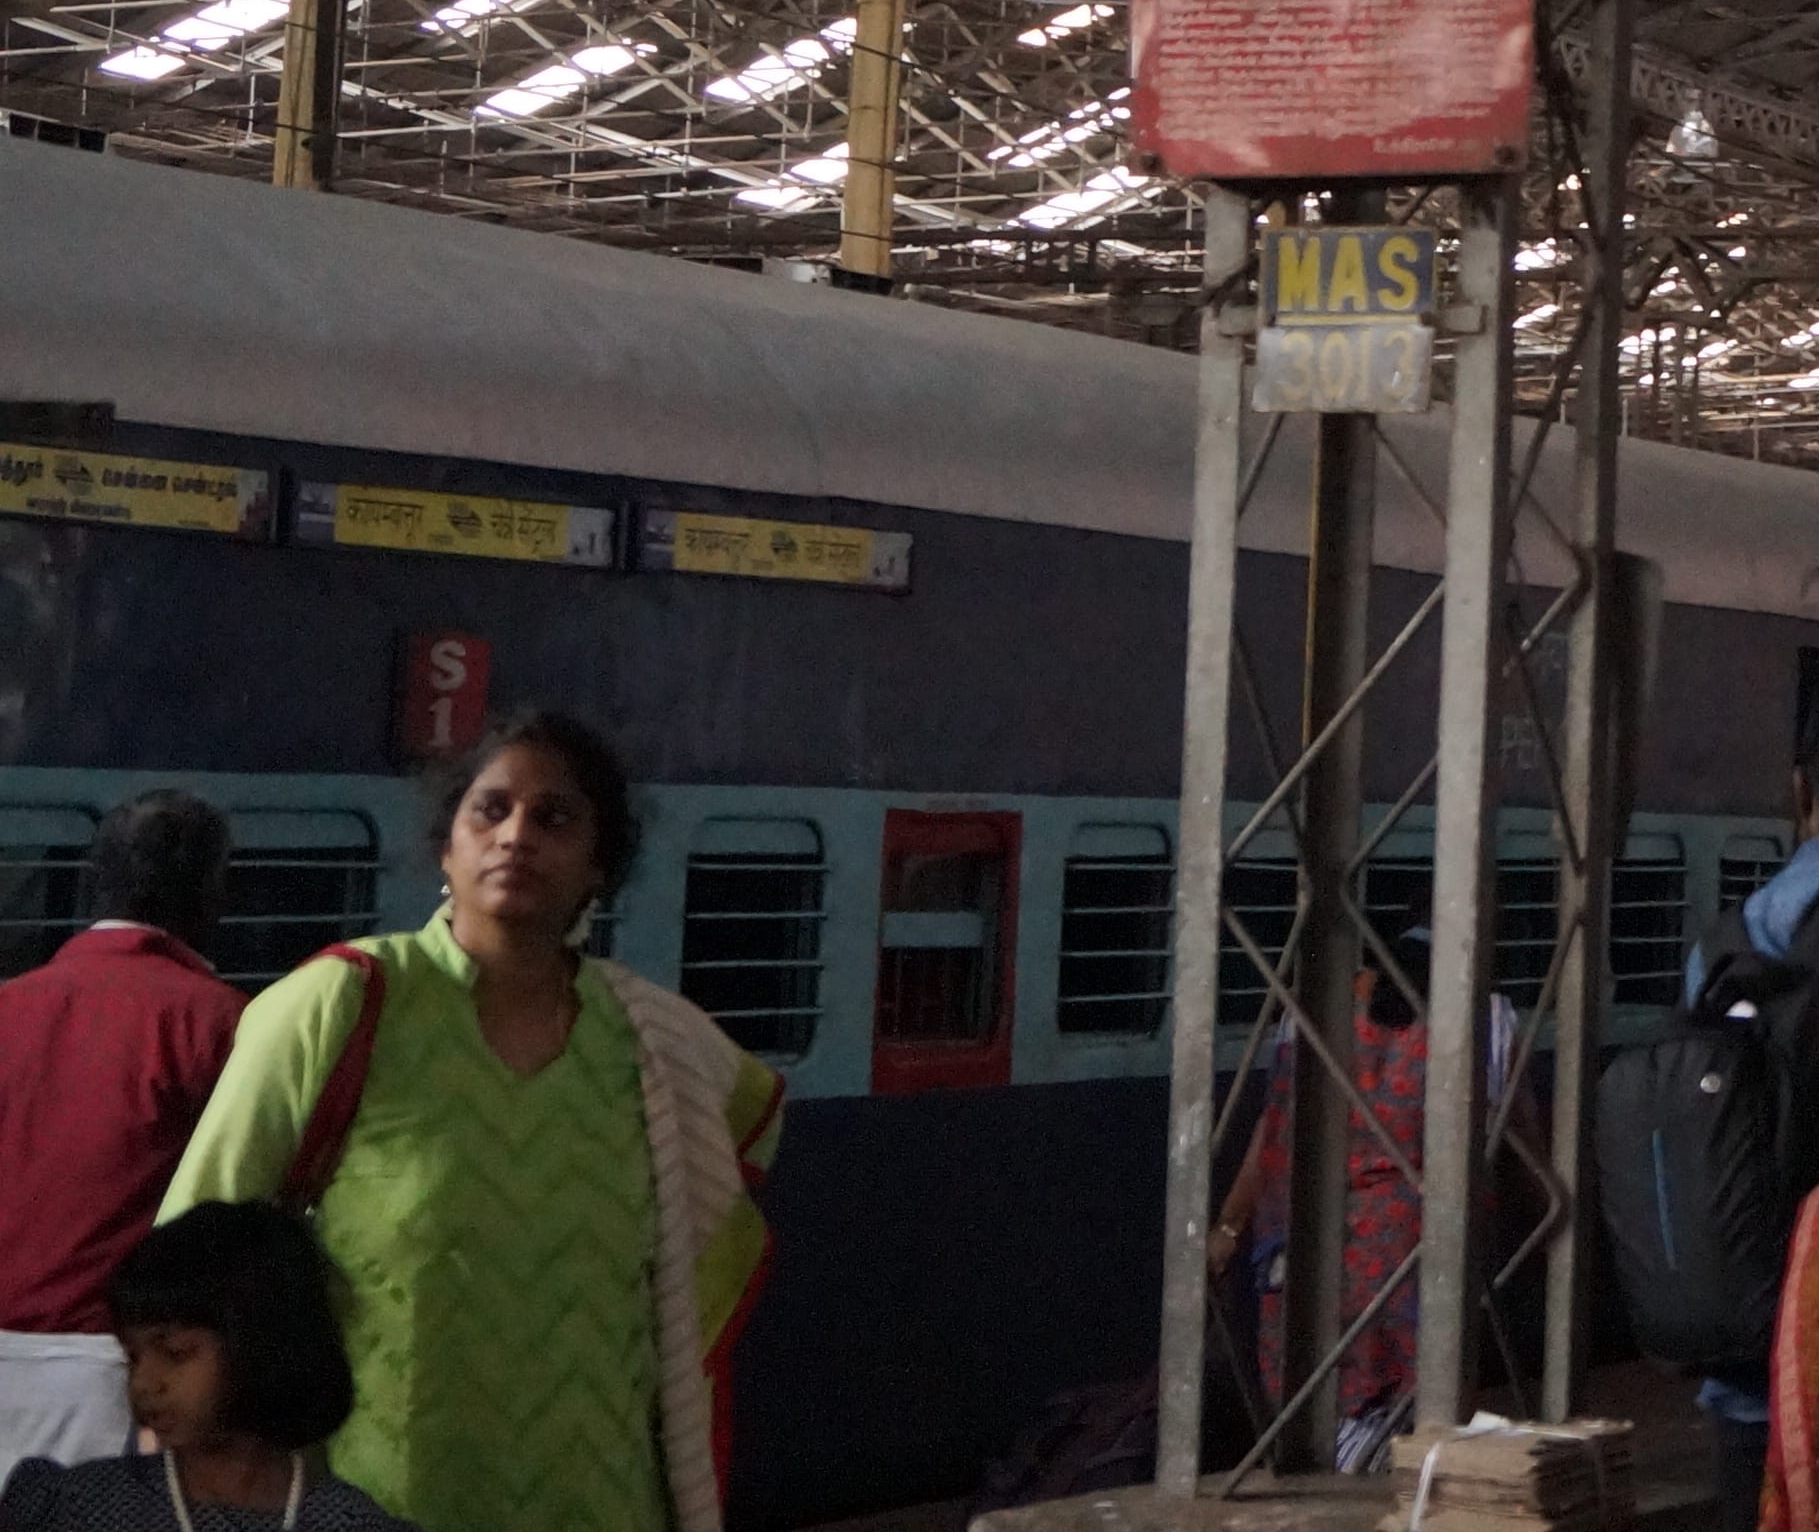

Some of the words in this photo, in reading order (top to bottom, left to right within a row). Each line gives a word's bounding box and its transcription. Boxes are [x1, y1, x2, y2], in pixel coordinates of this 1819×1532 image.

[1277, 234, 1420, 312] MAS
[429, 639, 469, 692] S
[426, 695, 455, 748] 1
